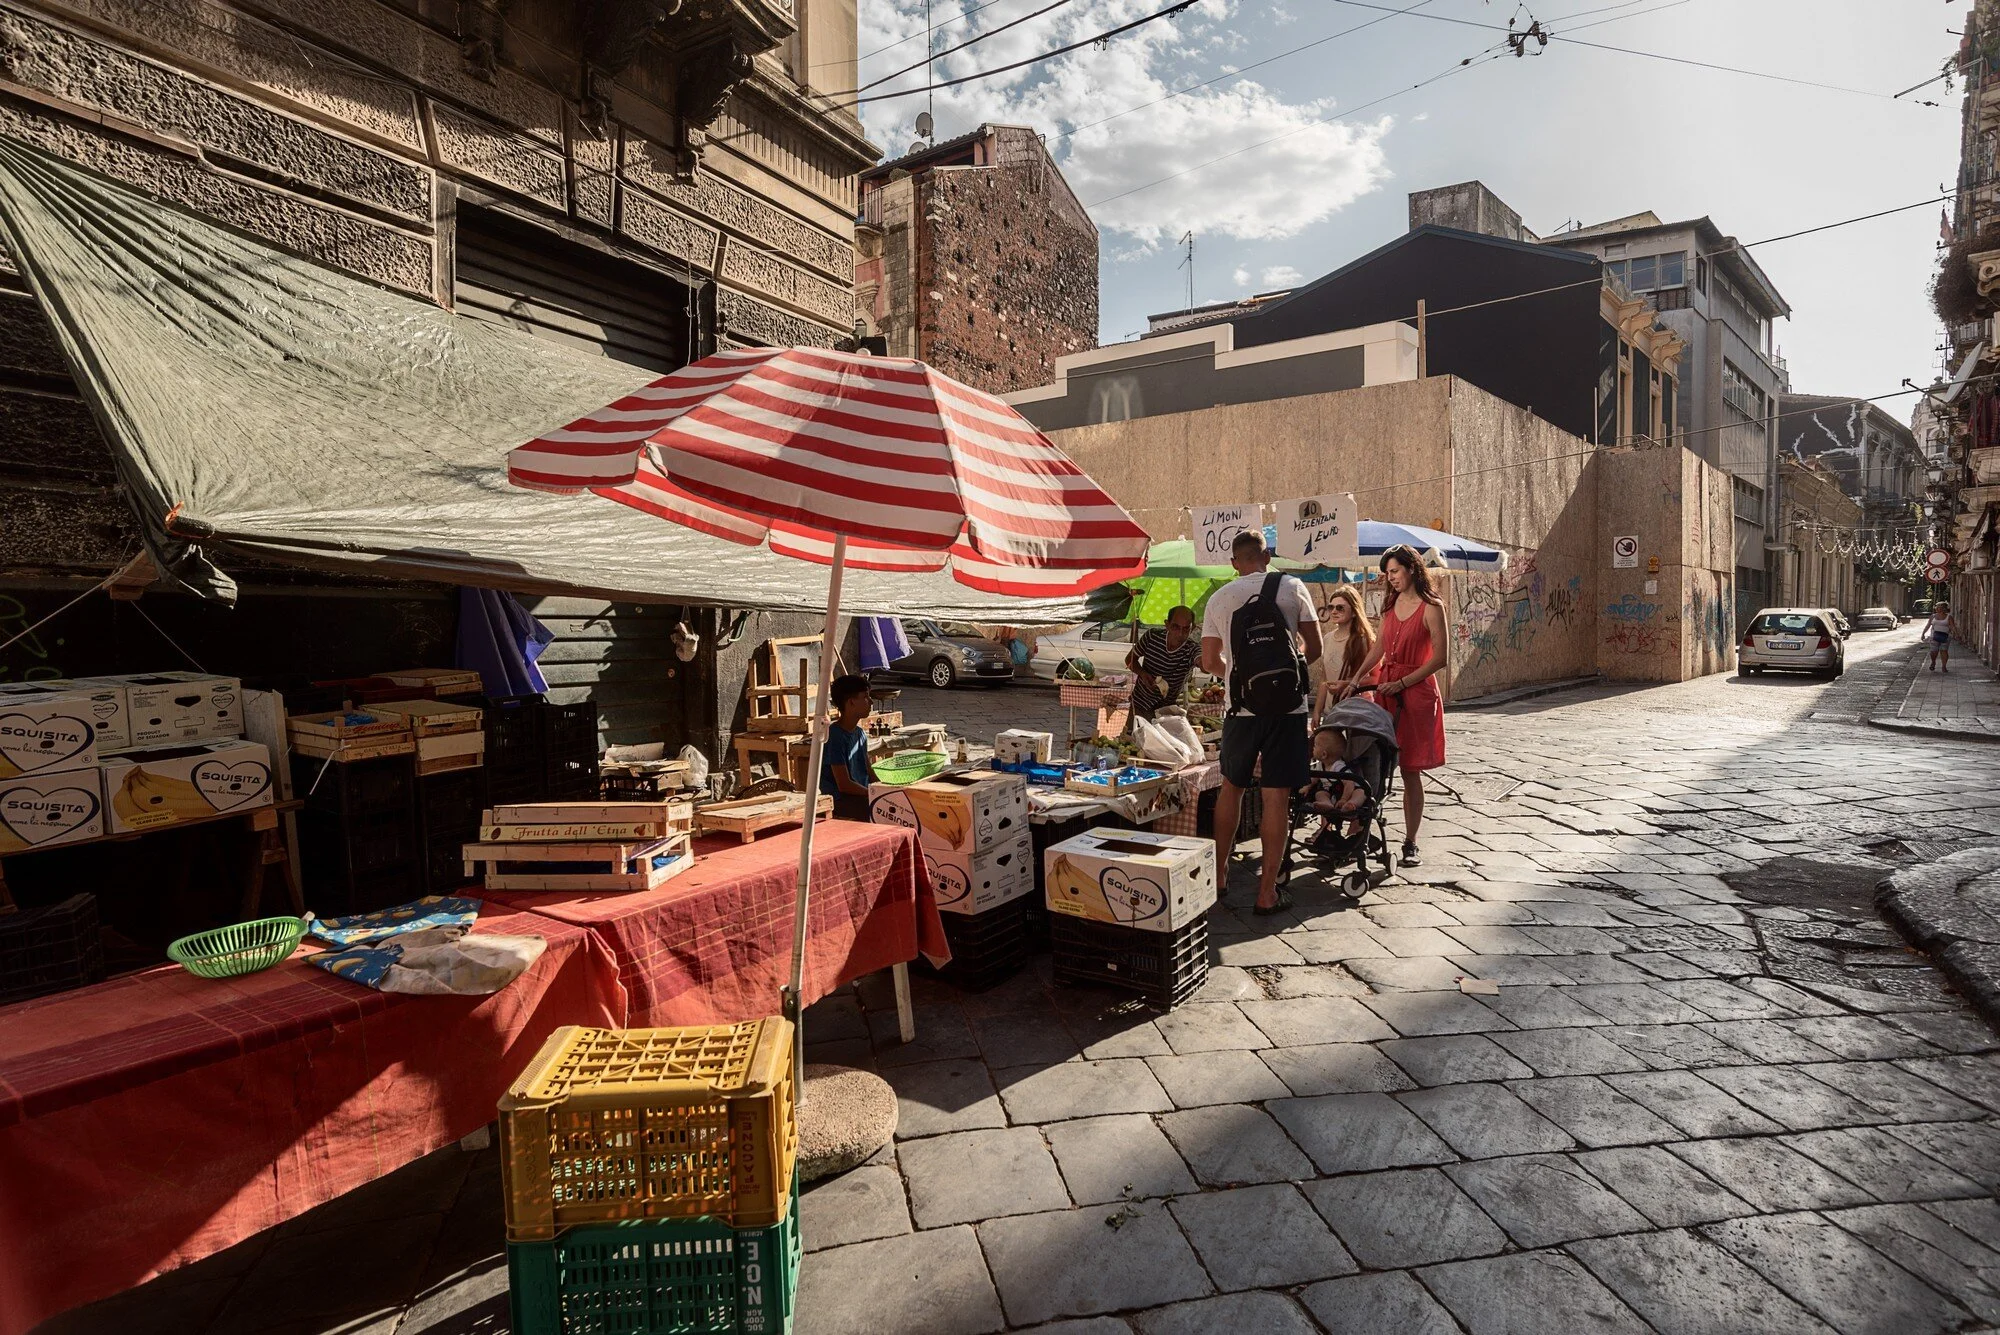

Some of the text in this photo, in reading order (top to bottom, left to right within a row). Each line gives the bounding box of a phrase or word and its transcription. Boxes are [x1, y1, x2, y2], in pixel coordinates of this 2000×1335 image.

[1, 727, 79, 743] SQUISITA
[201, 772, 260, 784] SQUISITA
[7, 801, 84, 813] SQUISITA
[564, 825, 587, 837] dell
[927, 868, 962, 890] QUISITA
[1107, 877, 1157, 906] SQUISITA
